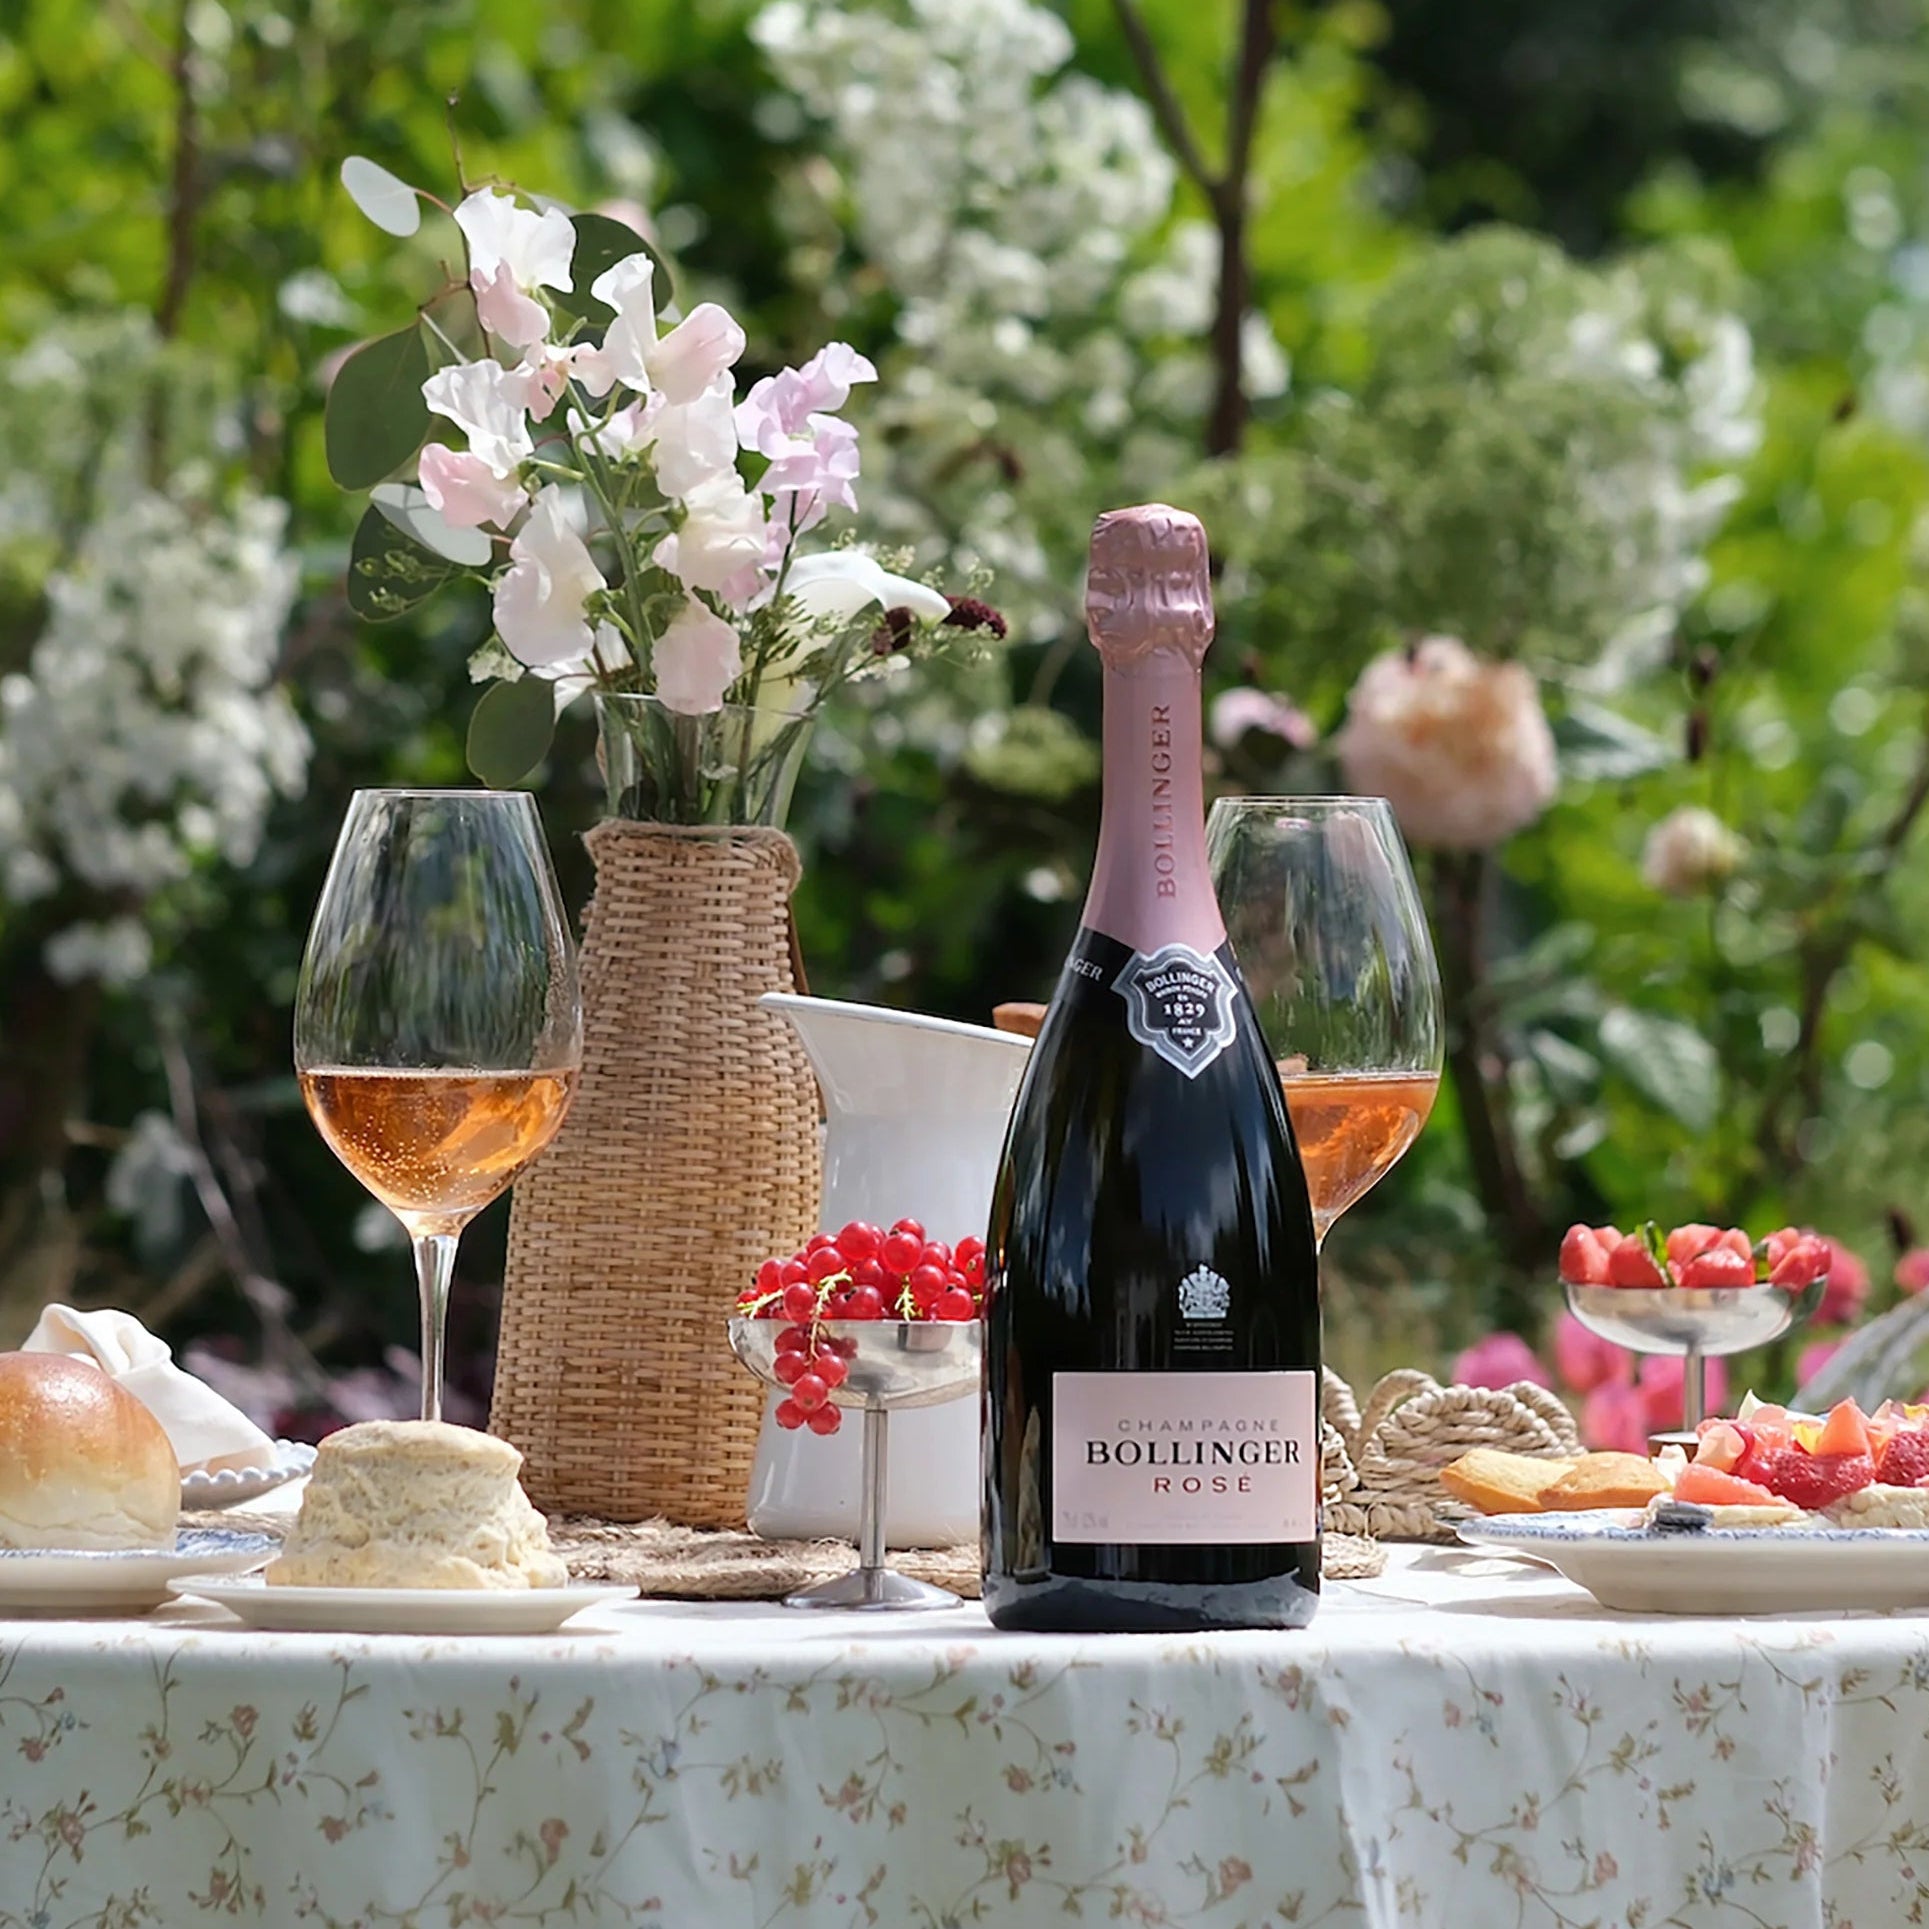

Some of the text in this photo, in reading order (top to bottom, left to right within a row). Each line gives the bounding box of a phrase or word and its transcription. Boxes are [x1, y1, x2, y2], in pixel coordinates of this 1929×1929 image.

[1151, 704, 1177, 899] BOLLINGER
[1145, 972, 1216, 993] BOLLINGER
[1163, 1002, 1206, 1018] 1829
[1118, 1419, 1279, 1433] CHAMPAGNE
[1086, 1439, 1300, 1466] BOLLINGER
[1153, 1472, 1252, 1494] ROSÉ
